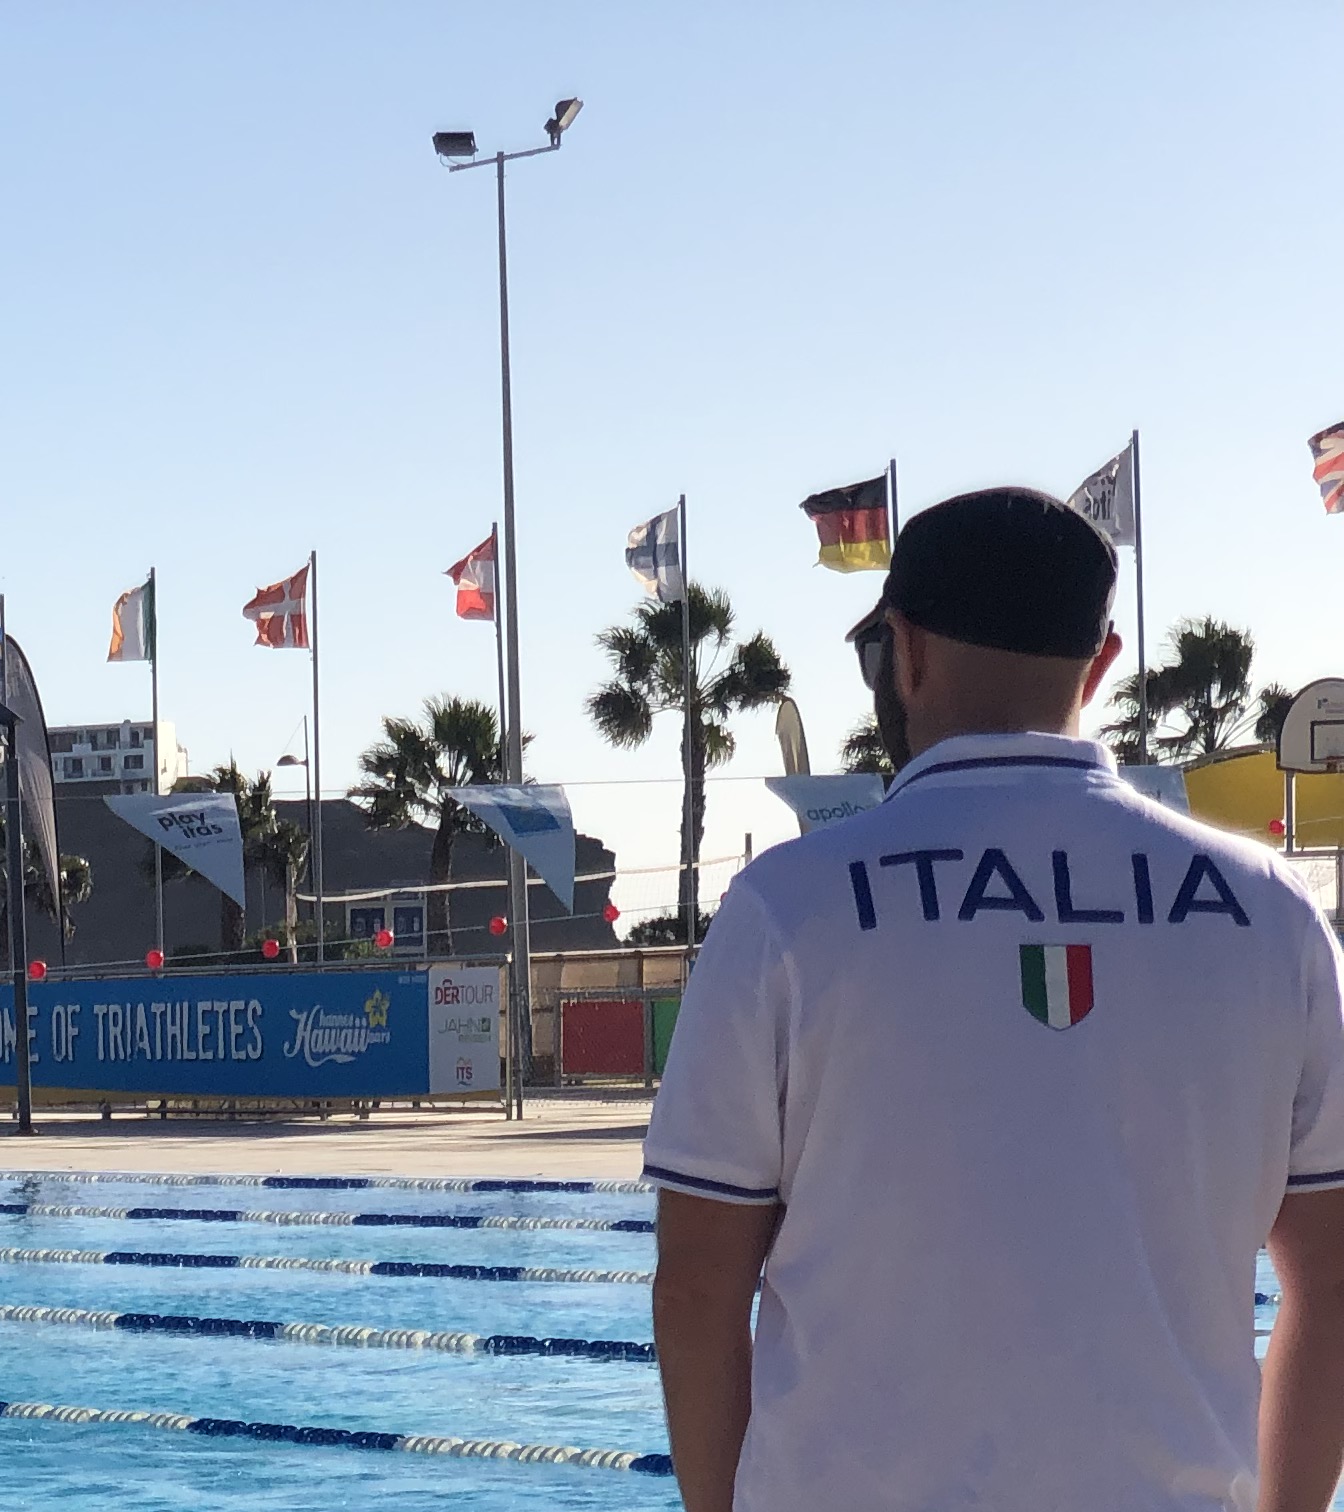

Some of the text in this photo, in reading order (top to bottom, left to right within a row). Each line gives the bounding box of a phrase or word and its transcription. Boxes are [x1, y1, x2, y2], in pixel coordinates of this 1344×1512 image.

[157, 812, 205, 832] play
[180, 822, 223, 839] itas
[849, 848, 1251, 931] ITALIA
[434, 982, 494, 1006] DERTOUR
[51, 1004, 81, 1062] OF
[93, 1000, 263, 1061] TRIATHLETES
[283, 1005, 369, 1067] Hawaii
[456, 1066, 473, 1081] ITS
